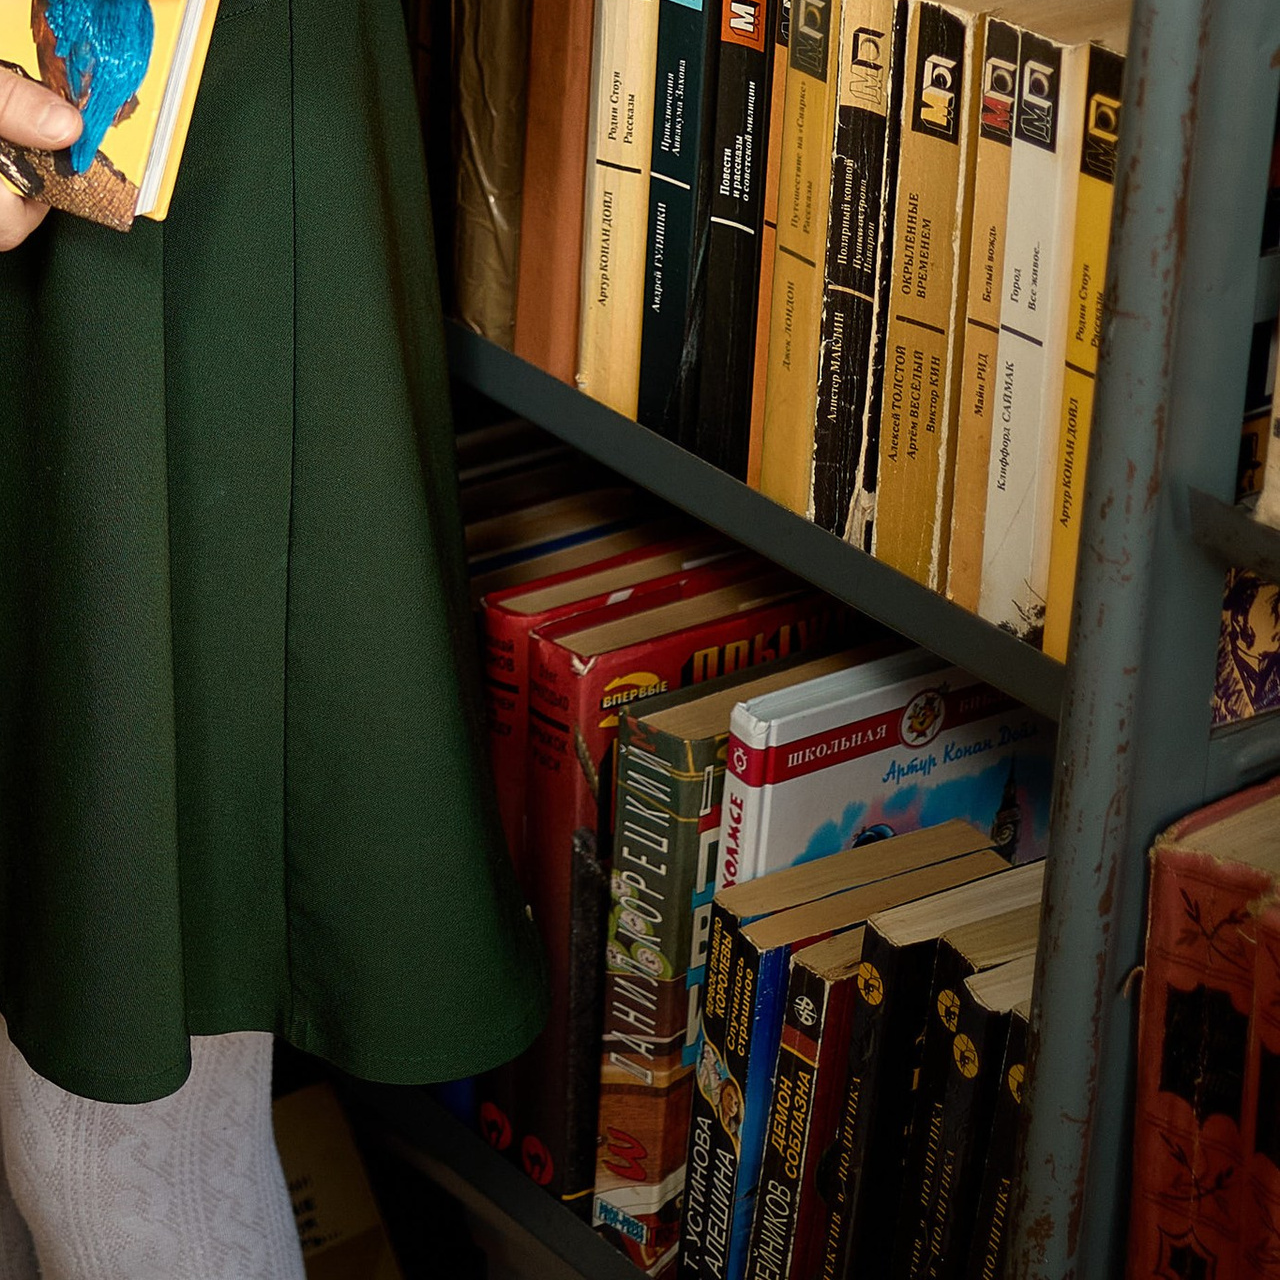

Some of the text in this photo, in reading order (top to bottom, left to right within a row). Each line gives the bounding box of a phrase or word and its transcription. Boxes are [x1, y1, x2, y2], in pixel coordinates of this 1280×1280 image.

[608, 71, 621, 141] Родни Стоун
[623, 93, 636, 145] Рассказы
[661, 72, 675, 152] Приключения
[672, 59, 687, 157] Аввакума Захова
[742, 81, 756, 202] о советской милиции
[719, 147, 732, 196] Повести
[732, 135, 744, 189] рассказы
[790, 80, 808, 229] Путешествие на «Снарке»
[597, 191, 614, 307] Артур КОНАН ДОЙЛ
[802, 180, 814, 235] Рассказы
[837, 158, 855, 265] Полярный конвой
[863, 221, 875, 274] Наварон
[901, 192, 920, 296] ОКРЫЛЁННЫЕ
[651, 202, 667, 313] Андрей ГУЛЯШКИ
[916, 218, 932, 299] ВРЕМЕНЕМ
[982, 225, 997, 303] Белый вождь
[1010, 268, 1022, 304] Город
[1027, 289, 1039, 312] Все
[782, 281, 796, 372] Джек ЛОНДОН
[1074, 263, 1091, 342] Родни Стоун
[1090, 291, 1104, 348] Рассказы
[827, 311, 845, 423] Алистер МАКЛИН
[887, 346, 906, 463] Алексей ТОЛСТОЙ
[906, 350, 924, 460] Артём ВЕСЁЛЫЙ
[926, 356, 941, 434] Виктор КИН
[974, 353, 989, 418] Майн РИД
[995, 360, 1015, 491] Клиффорд САЙМАК
[1059, 396, 1078, 528] Артур КОНАН ДОЙЛ
[601, 681, 669, 709] ВПЕРВЫЕ
[787, 723, 888, 768] ШКОЛЬНАЯ
[882, 741, 993, 785] Артур Конан
[608, 744, 673, 1084] ДАНИЛ КОРЕЦКИЙ
[704, 916, 723, 1019] ПЕРВОЕ ПРАВИЛО
[714, 932, 733, 1019] КОРОЛЕВЫ
[726, 956, 745, 1052] Случилось
[735, 968, 754, 1057] страшное
[771, 1074, 793, 1156] ДЕМОН
[785, 1070, 812, 1180] СОБЛАЗНА
[838, 1076, 861, 1182] ПОЛИТИКА
[684, 1113, 713, 1271] Т. УСТИНОВА
[705, 1148, 735, 1277] АЛЕШИНА
